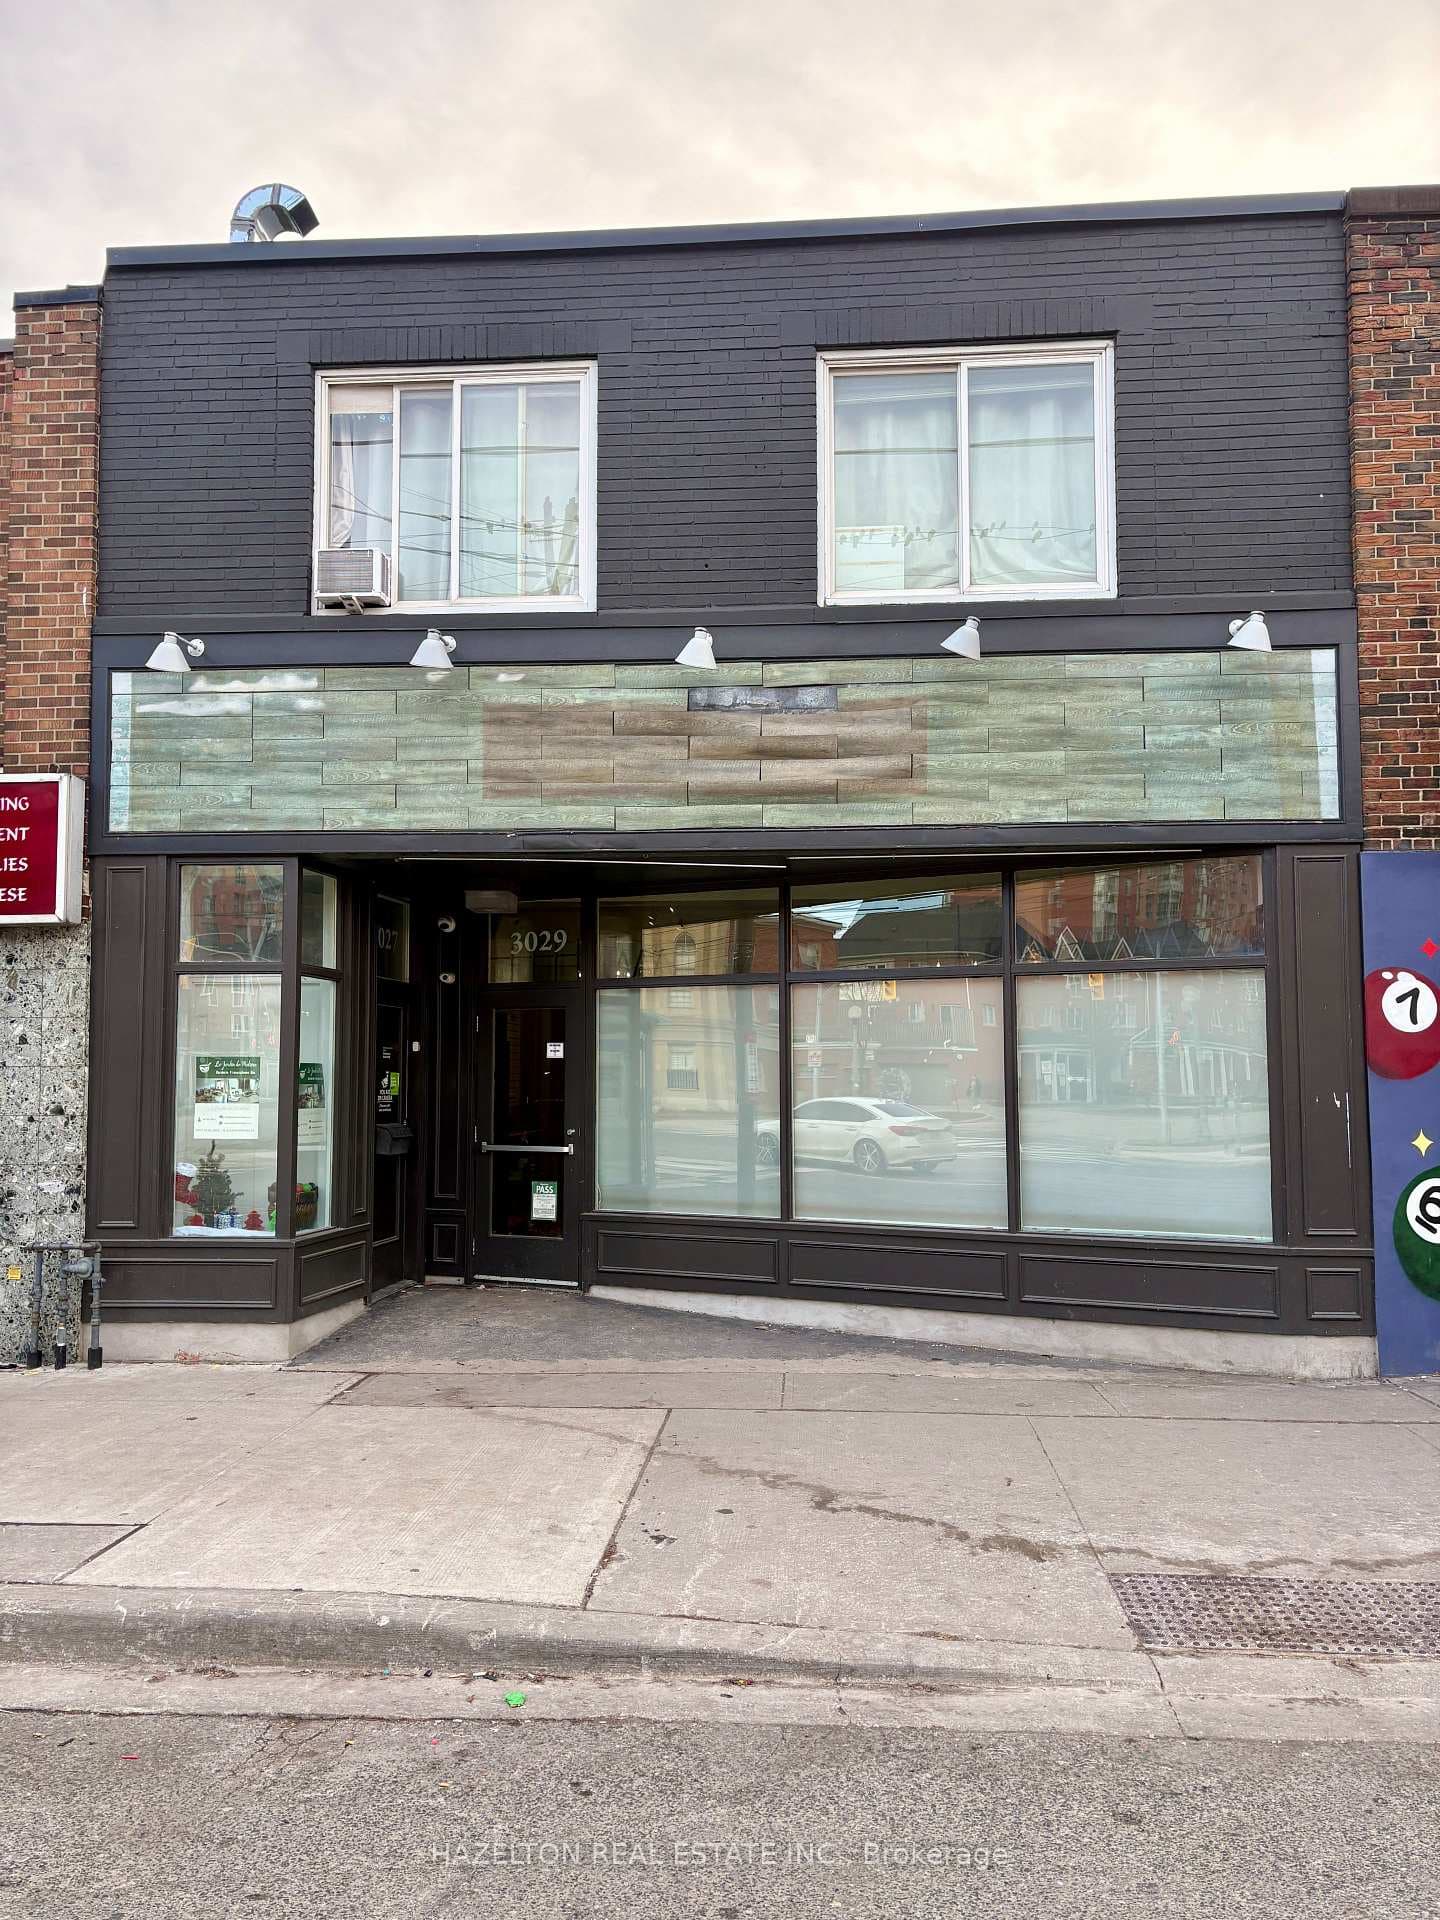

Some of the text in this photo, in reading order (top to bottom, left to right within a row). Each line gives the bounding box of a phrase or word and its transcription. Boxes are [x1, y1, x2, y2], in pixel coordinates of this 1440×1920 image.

[510, 929, 568, 954] 3029
[1395, 987, 1420, 1025] 7
[536, 1185, 554, 1194] PASS
[1418, 1185, 1440, 1226] 6
